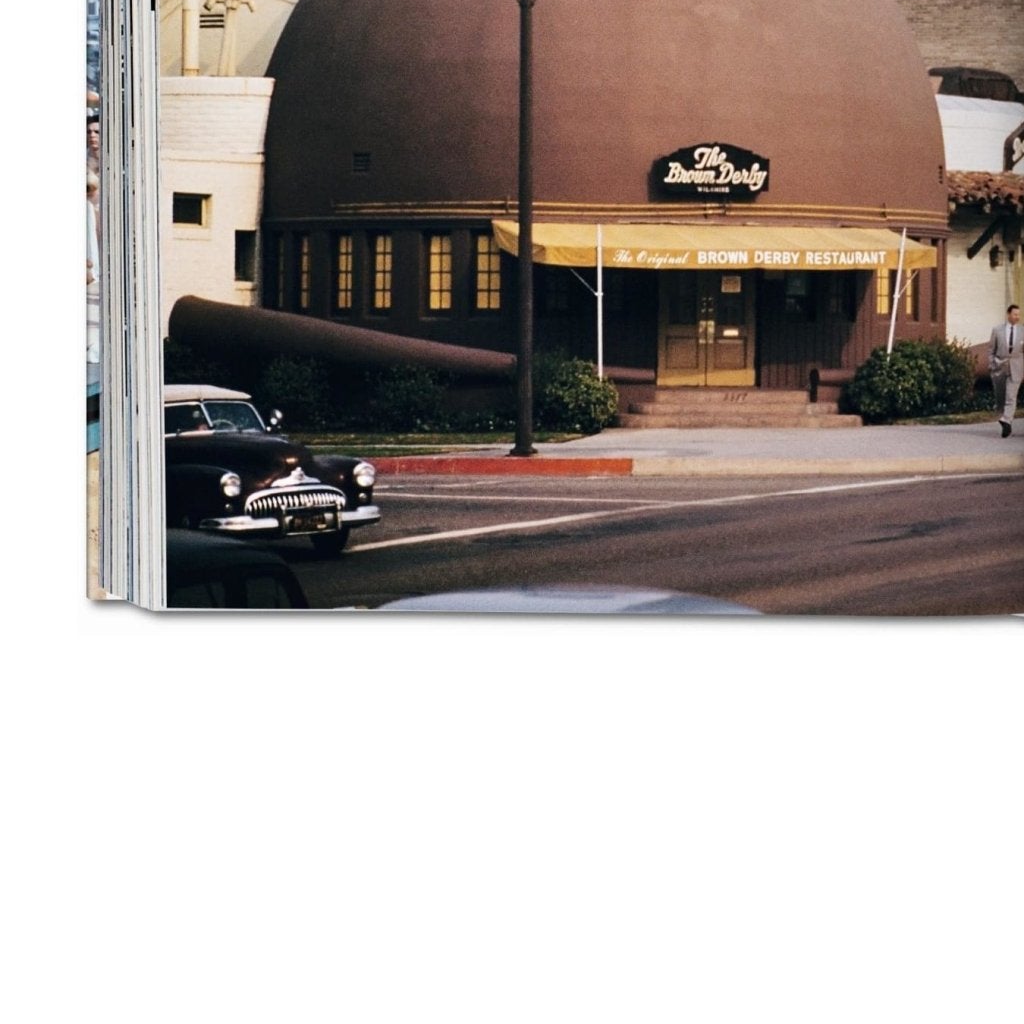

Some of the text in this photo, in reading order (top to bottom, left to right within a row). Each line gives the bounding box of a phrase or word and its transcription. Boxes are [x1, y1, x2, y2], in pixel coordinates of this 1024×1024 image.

[693, 146, 727, 169] The
[664, 162, 767, 191] Brown Derby
[612, 249, 886, 269] The Original BROWN DERBY RESTAURANT
